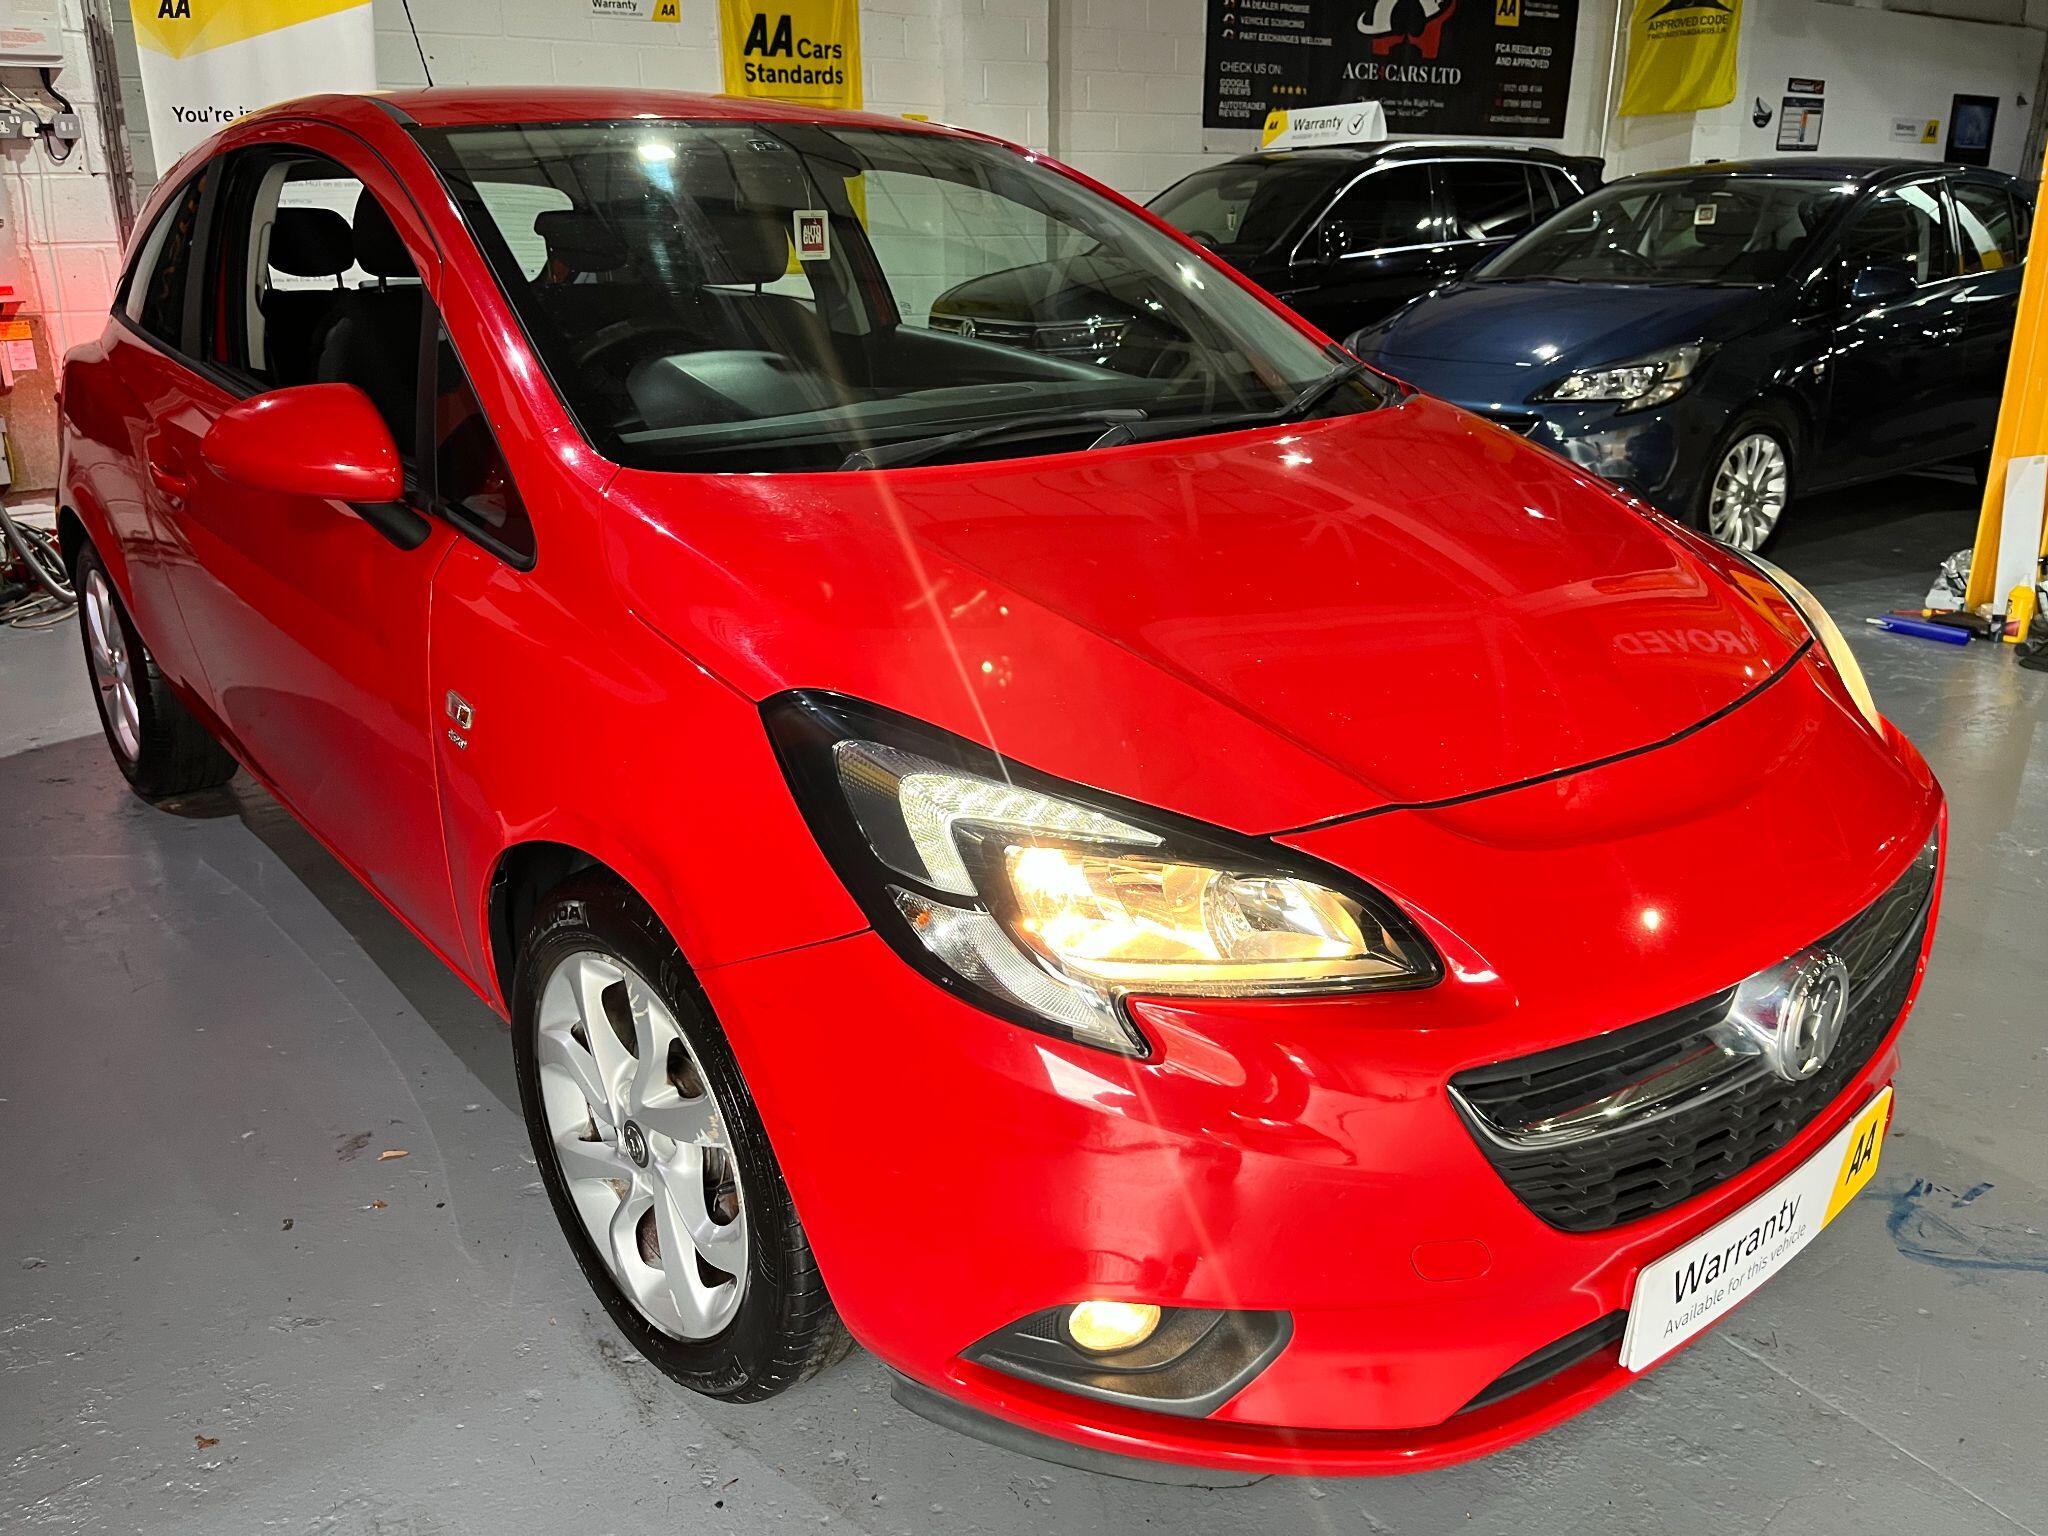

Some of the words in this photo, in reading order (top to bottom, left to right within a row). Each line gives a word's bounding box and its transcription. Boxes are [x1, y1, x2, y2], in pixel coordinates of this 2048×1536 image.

[158, 0, 191, 19] AA
[661, 4, 676, 16] AA
[1497, 0, 1516, 16] AA
[1648, 16, 1699, 31] APPROVED
[1700, 14, 1729, 25] CODE
[743, 13, 794, 58] AA
[797, 38, 843, 59] Cars
[744, 62, 844, 85] Standards
[1220, 61, 1252, 73] CHECK
[1253, 63, 1267, 74] US
[1431, 66, 1461, 85] LTD
[172, 106, 234, 122] You're
[1293, 116, 1344, 131] Warranty
[803, 224, 822, 235] AUTO
[1846, 1120, 1878, 1185] AA
[1674, 1193, 1802, 1304] Warranty
[1664, 1289, 1725, 1339] Available
[1727, 1273, 1748, 1296] for
[1747, 1256, 1768, 1279] this
[1770, 1223, 1807, 1262] vehicle
